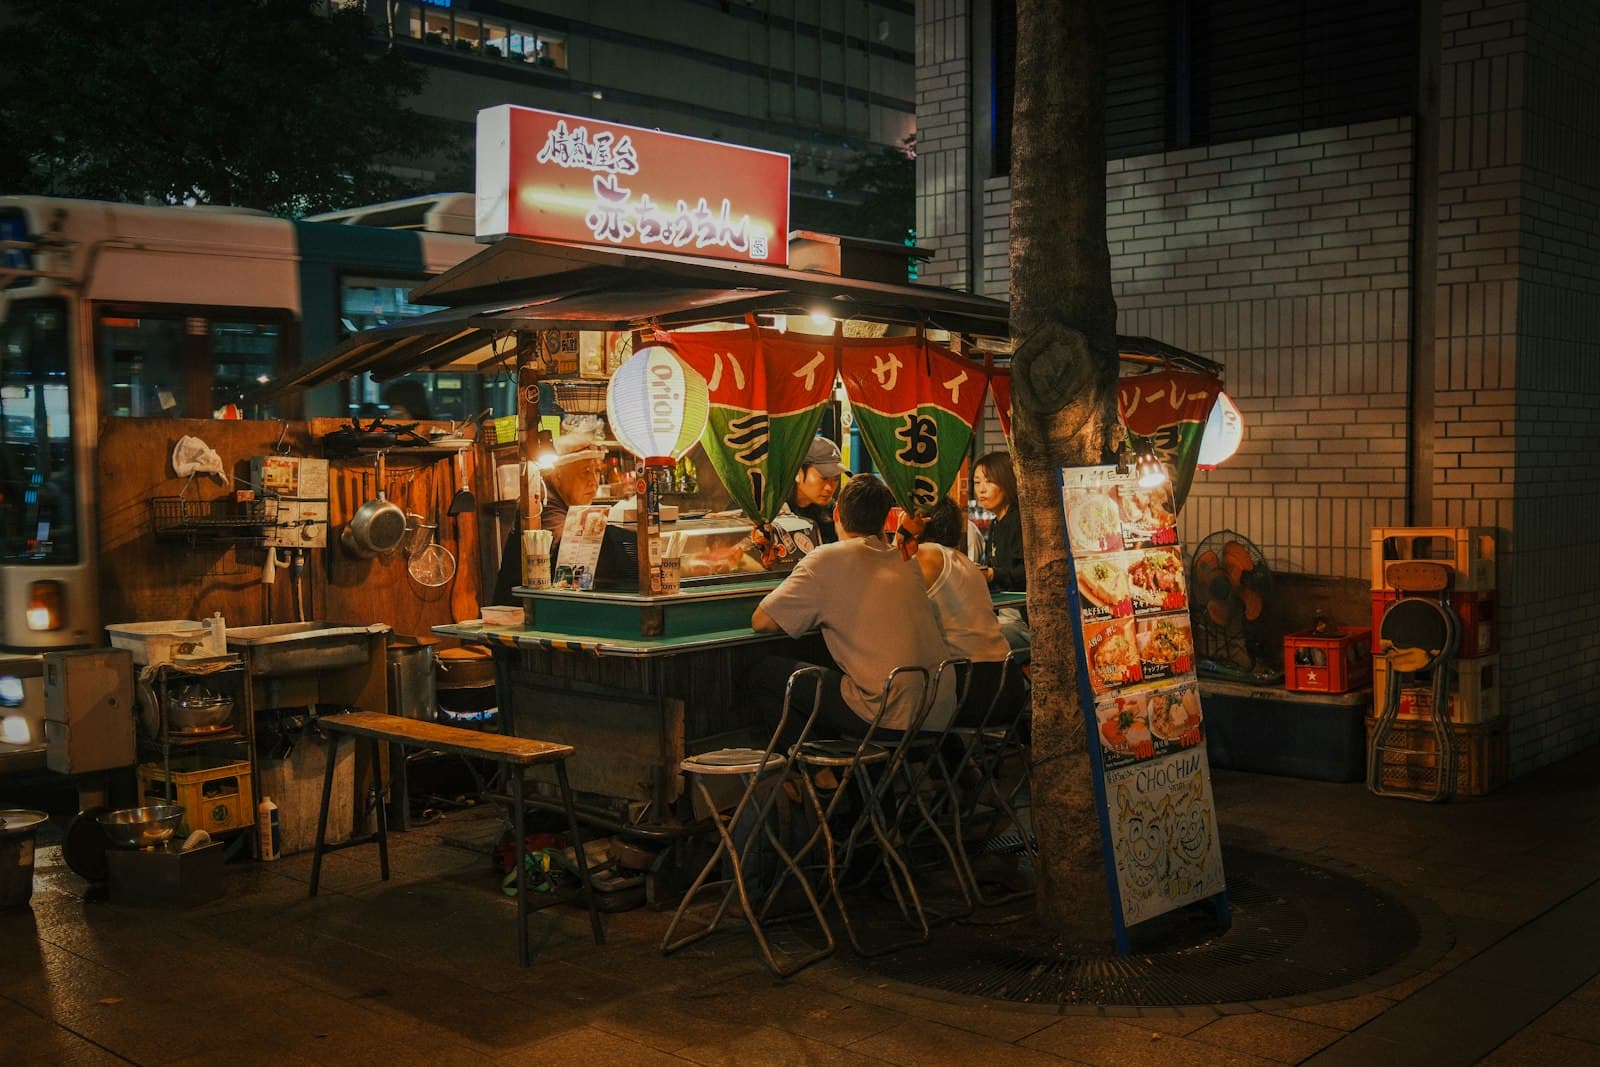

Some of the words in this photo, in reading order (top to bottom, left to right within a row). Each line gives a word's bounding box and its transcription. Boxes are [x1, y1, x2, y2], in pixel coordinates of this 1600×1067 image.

[538, 121, 638, 174] 情熱屋台
[586, 175, 749, 251] 赤ちょうちん
[651, 364, 679, 433] Orion
